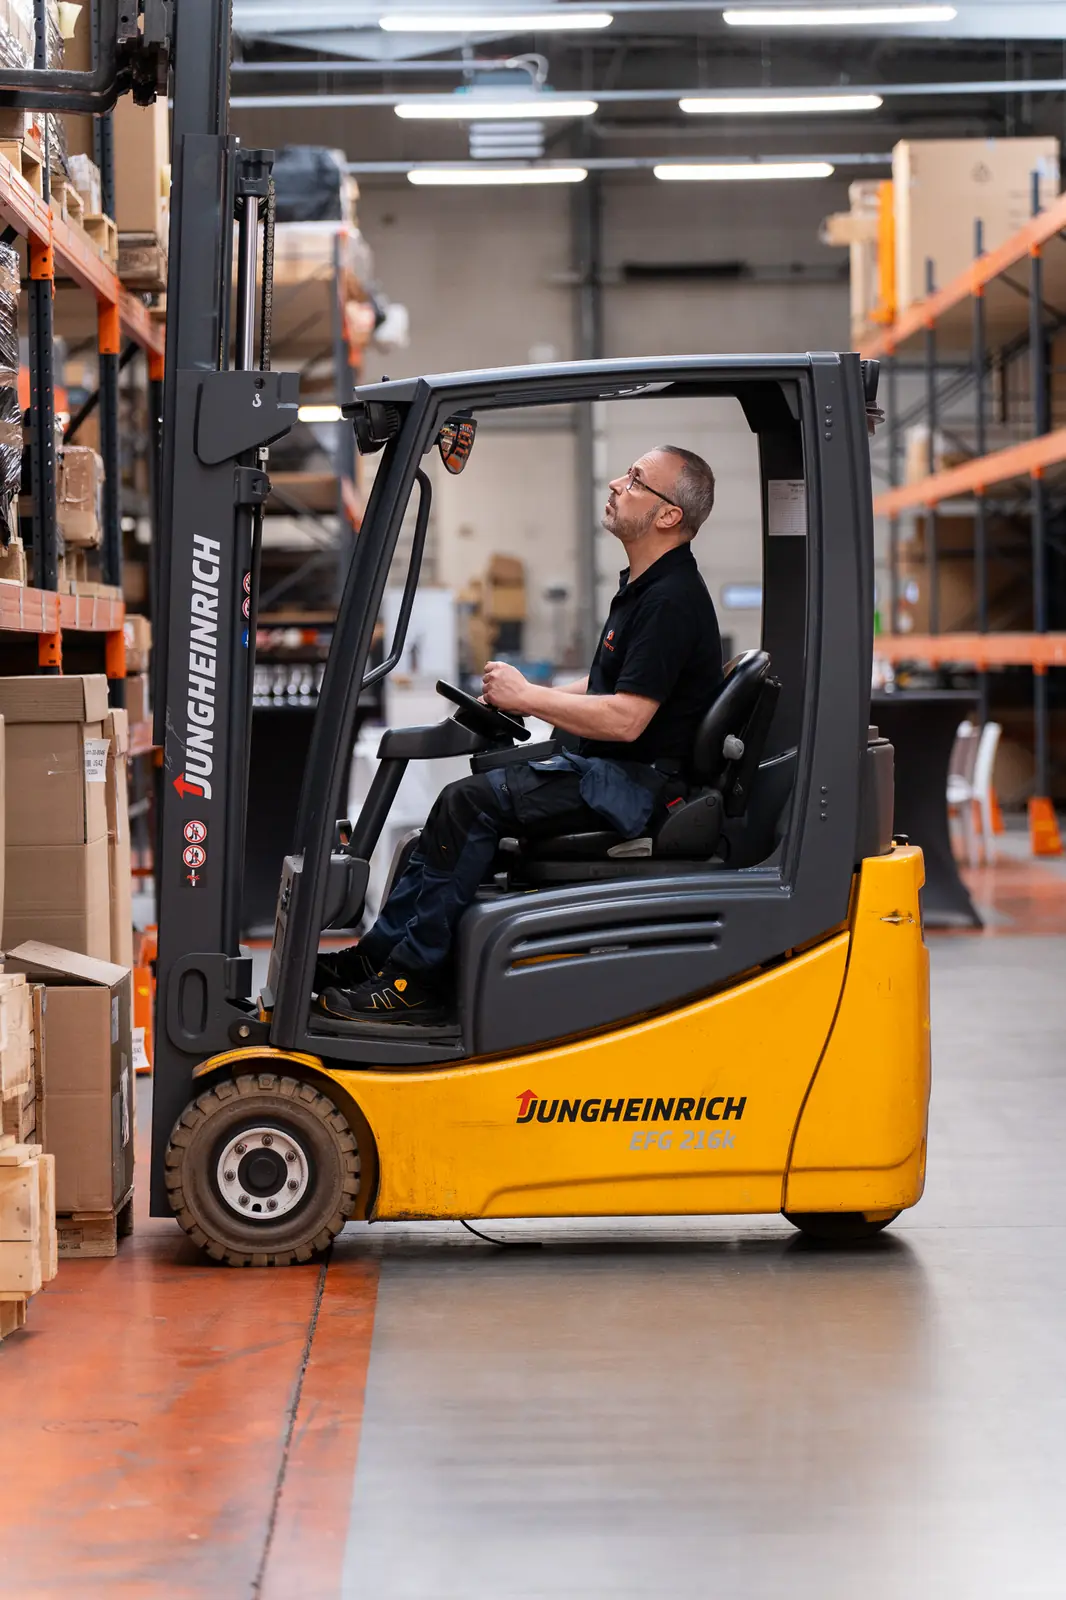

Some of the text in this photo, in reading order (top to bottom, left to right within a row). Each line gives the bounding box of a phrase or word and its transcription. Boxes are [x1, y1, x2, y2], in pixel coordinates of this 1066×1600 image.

[185, 533, 221, 800] JUNGHEINRICH
[516, 1096, 747, 1124] JUNGHEINRICH
[629, 1129, 736, 1150] EFG 216k
